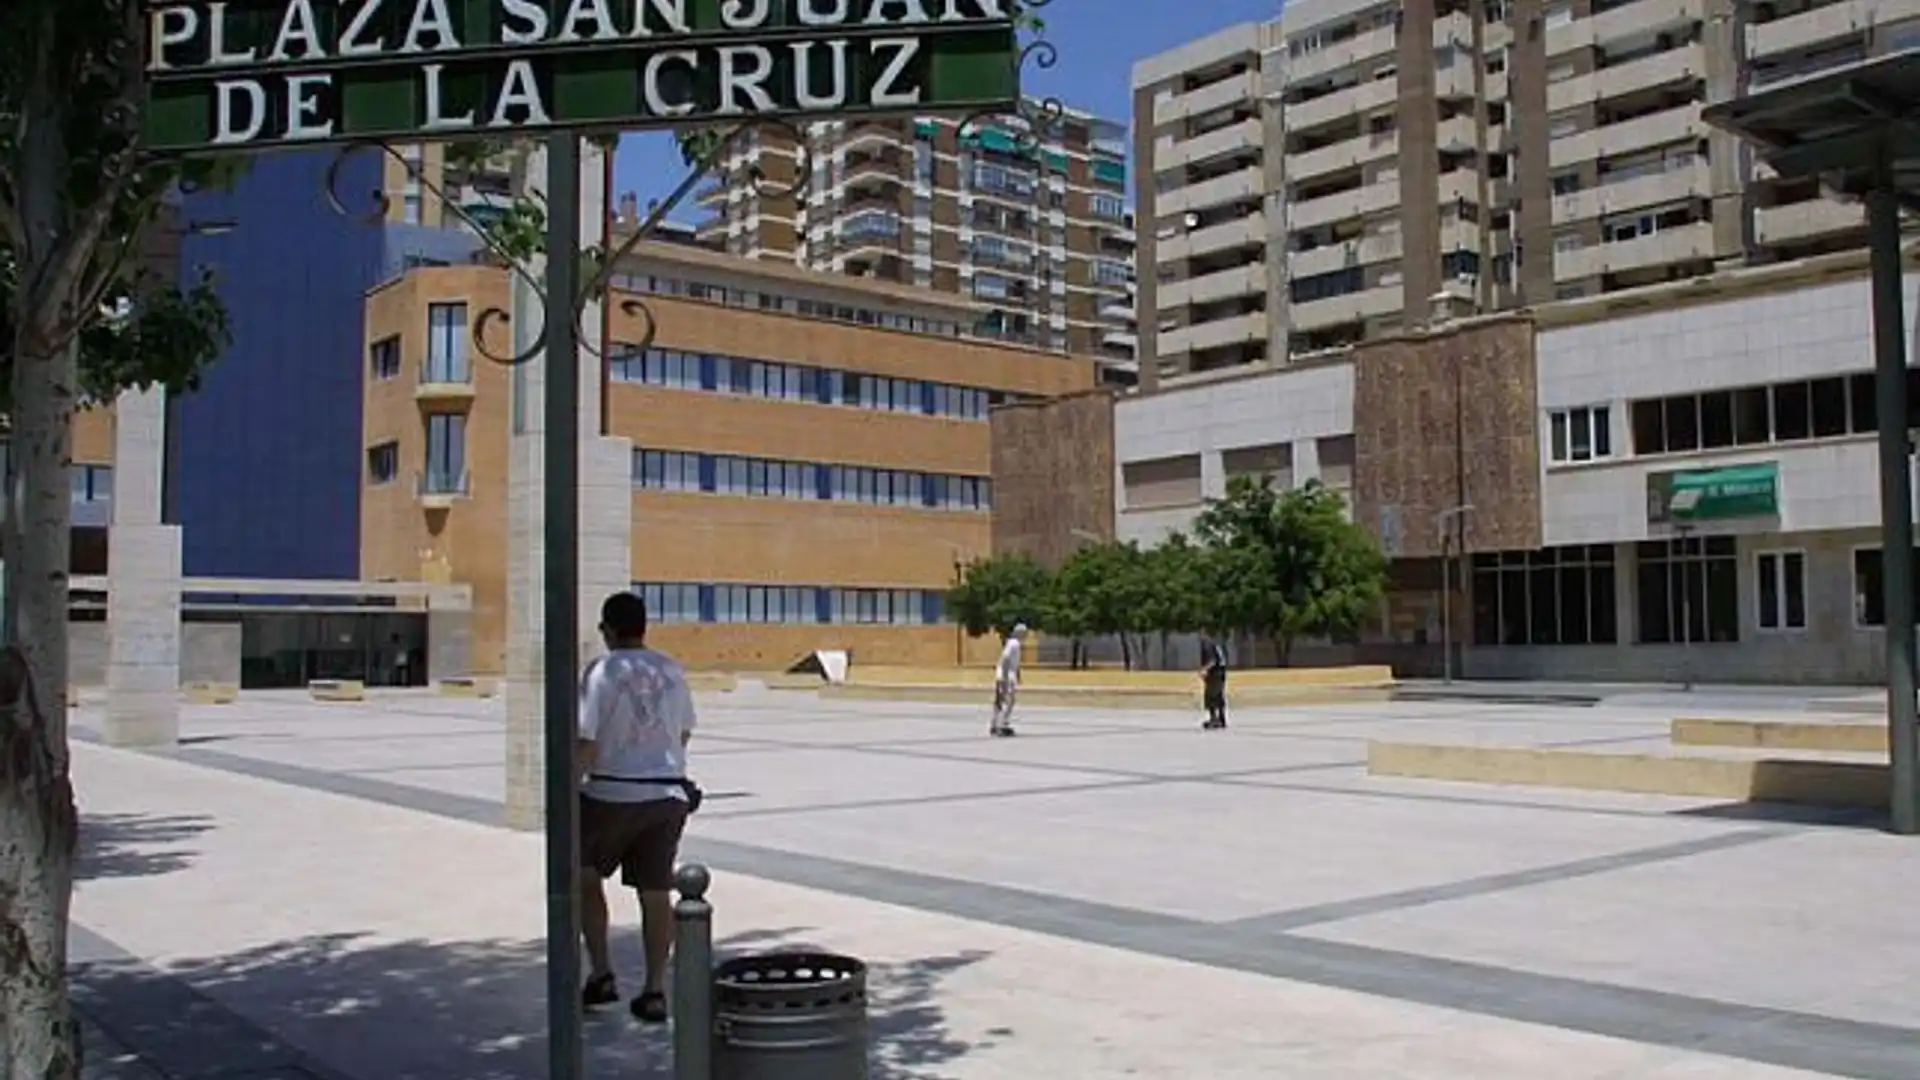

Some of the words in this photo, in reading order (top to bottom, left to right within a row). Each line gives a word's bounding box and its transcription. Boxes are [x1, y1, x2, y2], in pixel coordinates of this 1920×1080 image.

[147, 0, 461, 70] PLAZA
[214, 75, 333, 144] DE
[420, 60, 551, 130] LA
[644, 38, 921, 117] CRUZ
